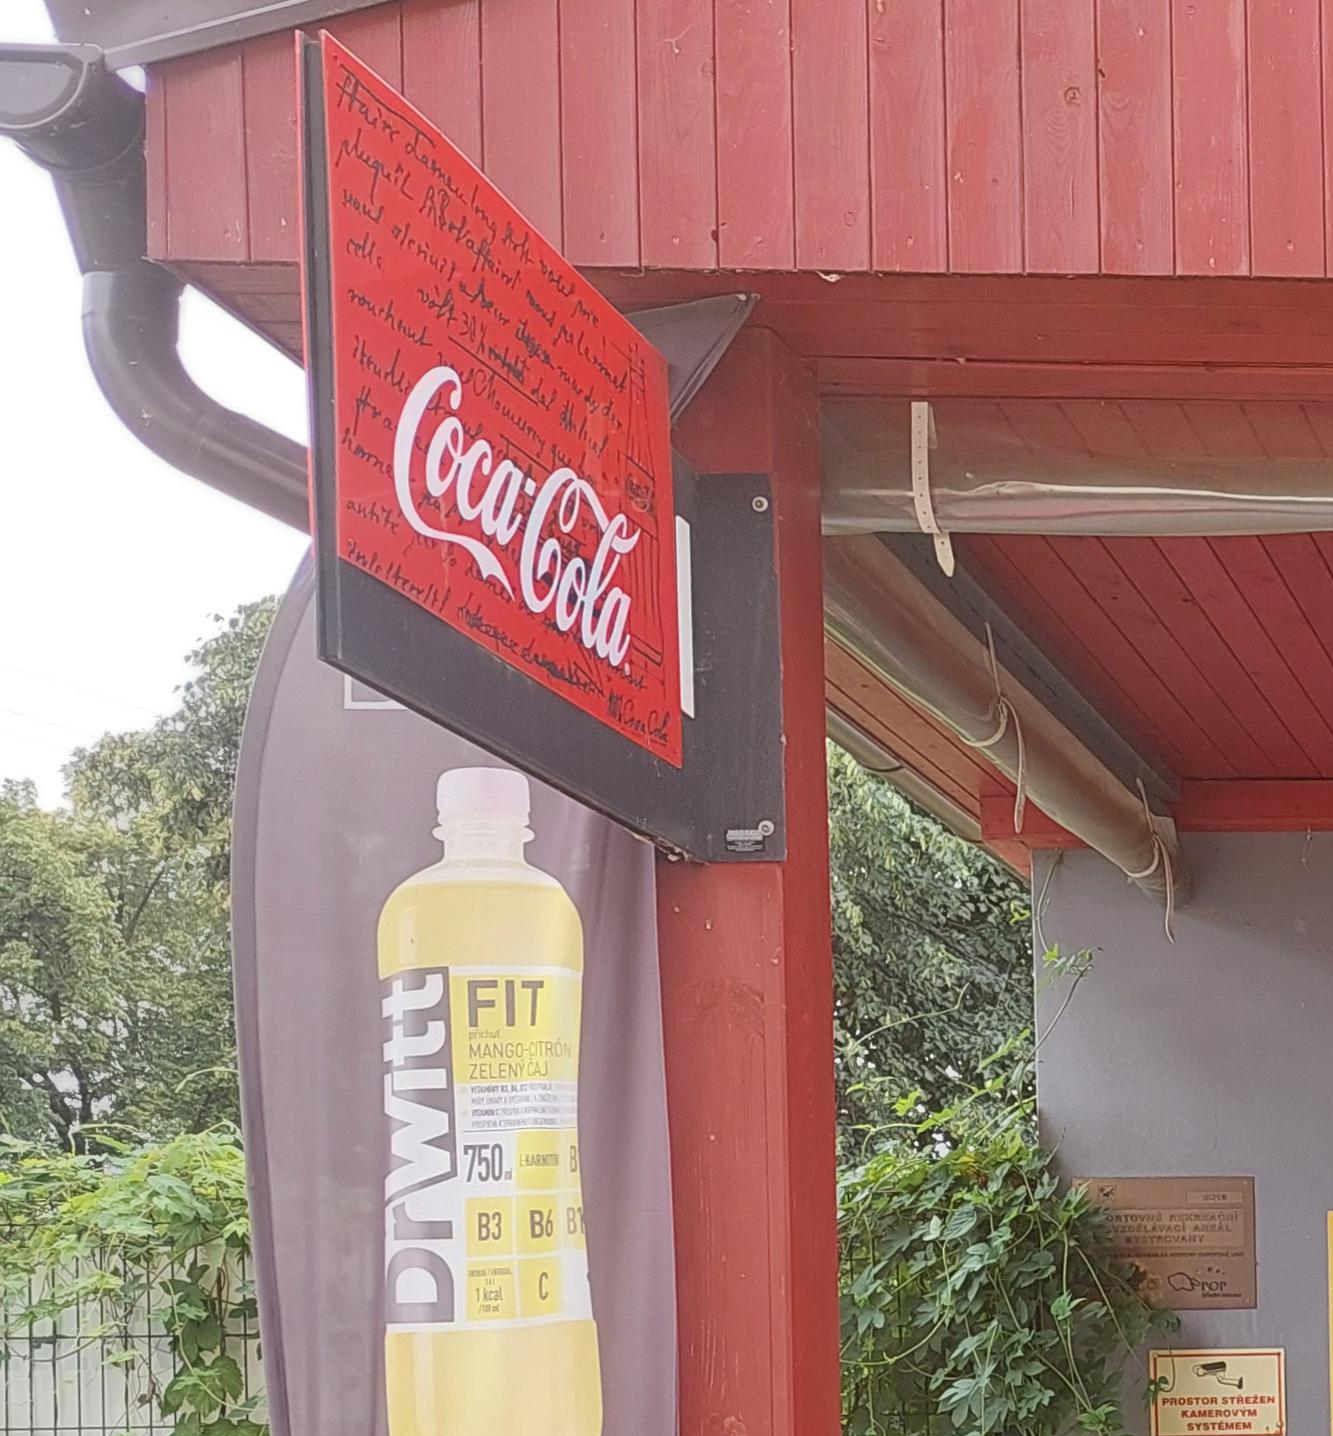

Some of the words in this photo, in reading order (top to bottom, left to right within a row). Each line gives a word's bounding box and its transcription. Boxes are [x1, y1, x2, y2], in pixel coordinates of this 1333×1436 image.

[467, 979, 545, 1028] FIT
[463, 1143, 503, 1182] 750
[477, 1211, 502, 1241] B3
[529, 1209, 553, 1239] B6
[538, 1272, 549, 1300] C
[1162, 1396, 1218, 1406] PROSTOR
[1181, 1407, 1258, 1419] KAMEROVÝM
[1187, 1420, 1252, 1431] SYSTÉMEM
